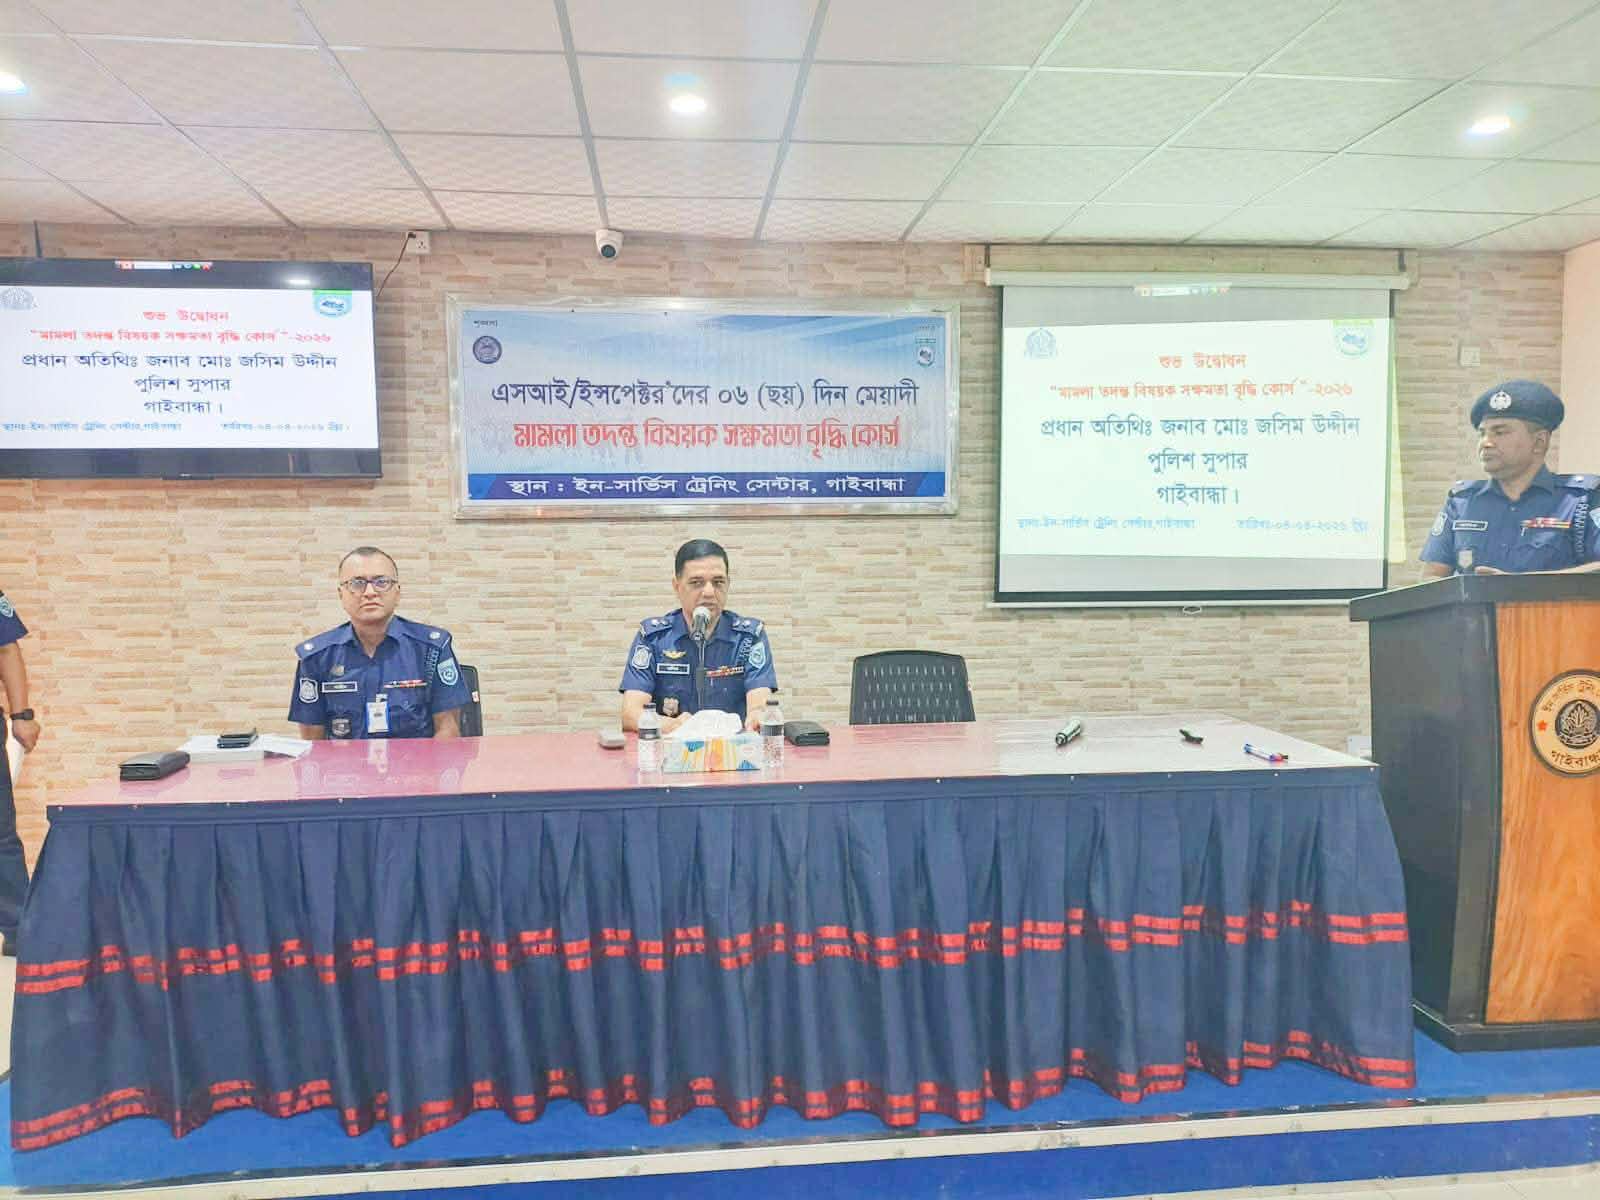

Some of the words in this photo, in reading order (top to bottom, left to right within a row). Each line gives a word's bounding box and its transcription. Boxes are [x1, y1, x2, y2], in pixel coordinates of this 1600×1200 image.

[22, 354, 66, 368] প্রধান
[75, 351, 138, 368] অতিথিঃ
[145, 354, 191, 368] জনাব
[199, 353, 231, 368] মোঃ
[239, 352, 284, 368] জসিম
[293, 352, 337, 368] উদ্দীন
[135, 374, 180, 393] পুলিশ
[187, 379, 232, 393] সুপার
[718, 385, 749, 406] ০৬
[758, 382, 804, 411] (ছয়)
[813, 378, 849, 406] দিন
[856, 378, 920, 406] মেয়াদী
[144, 399, 210, 415] গাইবান্ধা
[1041, 419, 1084, 437] প্রধান
[1090, 414, 1153, 437] অতিথিঃ
[1160, 418, 1208, 436] জনাব
[1213, 417, 1249, 436] মোঃ
[1254, 411, 1305, 435] জসিম
[1311, 410, 1360, 435] উদ্দীন
[513, 423, 578, 448] মামলা
[582, 423, 638, 448] তদন্ত
[643, 417, 719, 448] বিষয়ক
[722, 423, 802, 448] সক্ষমতা
[806, 417, 849, 459] বৃদ্ধি
[851, 415, 900, 448] কোর্স
[1148, 447, 1196, 473] পুলিশ
[1201, 452, 1249, 473] সুপার
[506, 479, 550, 496] স্থান
[571, 476, 679, 495] ইন-সার্ভিস
[685, 475, 740, 494] ট্রেনিং
[746, 477, 818, 495] সেন্টার,
[825, 476, 906, 493] গাইবান্ধা
[1157, 483, 1228, 506] গাইবান্ধা
